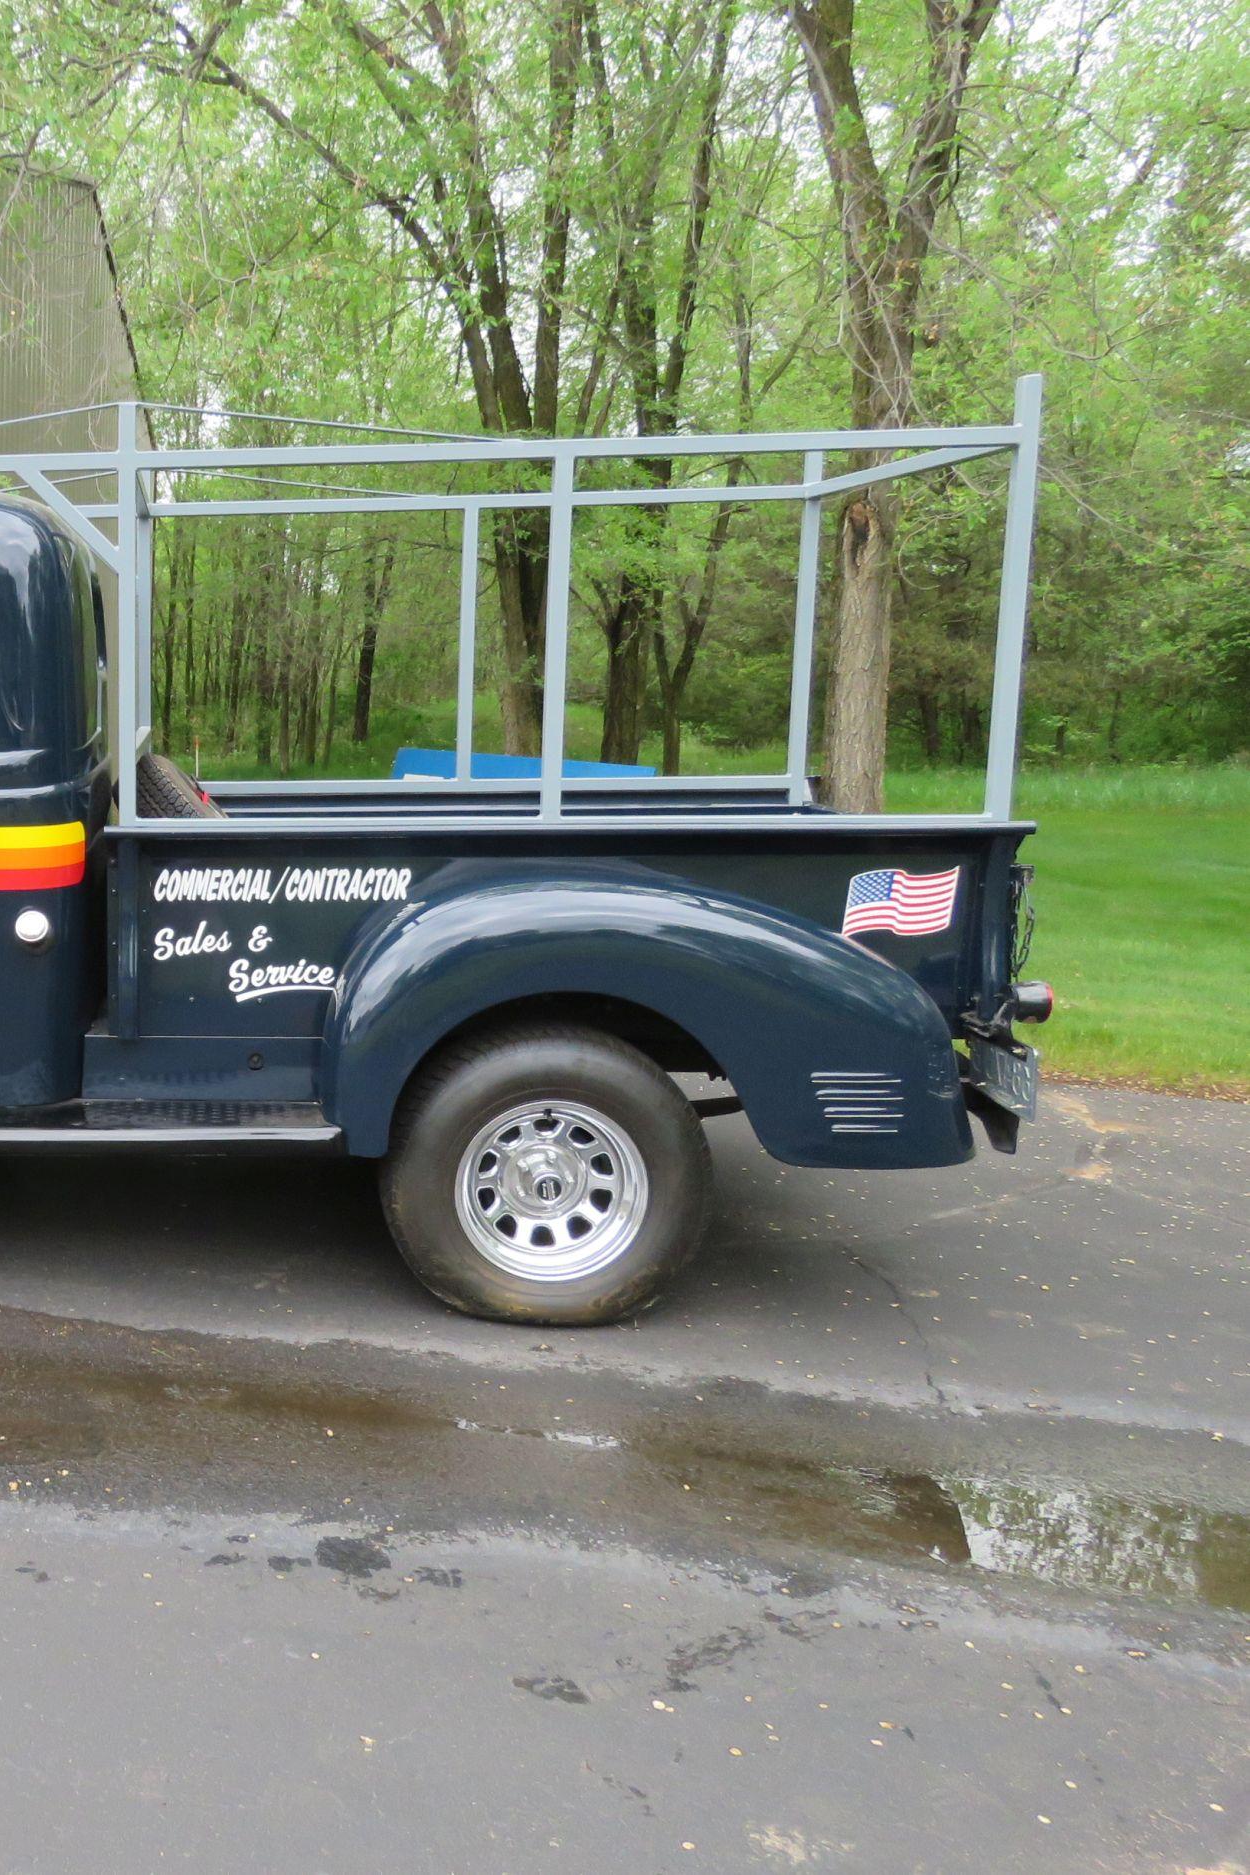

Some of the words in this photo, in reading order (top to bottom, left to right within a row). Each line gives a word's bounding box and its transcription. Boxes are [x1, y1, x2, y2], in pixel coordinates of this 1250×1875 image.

[153, 867, 412, 904] COMMERCIAL/CONTRACTOR
[153, 921, 231, 961] Sales
[247, 925, 273, 952] &
[228, 958, 335, 993] Service
